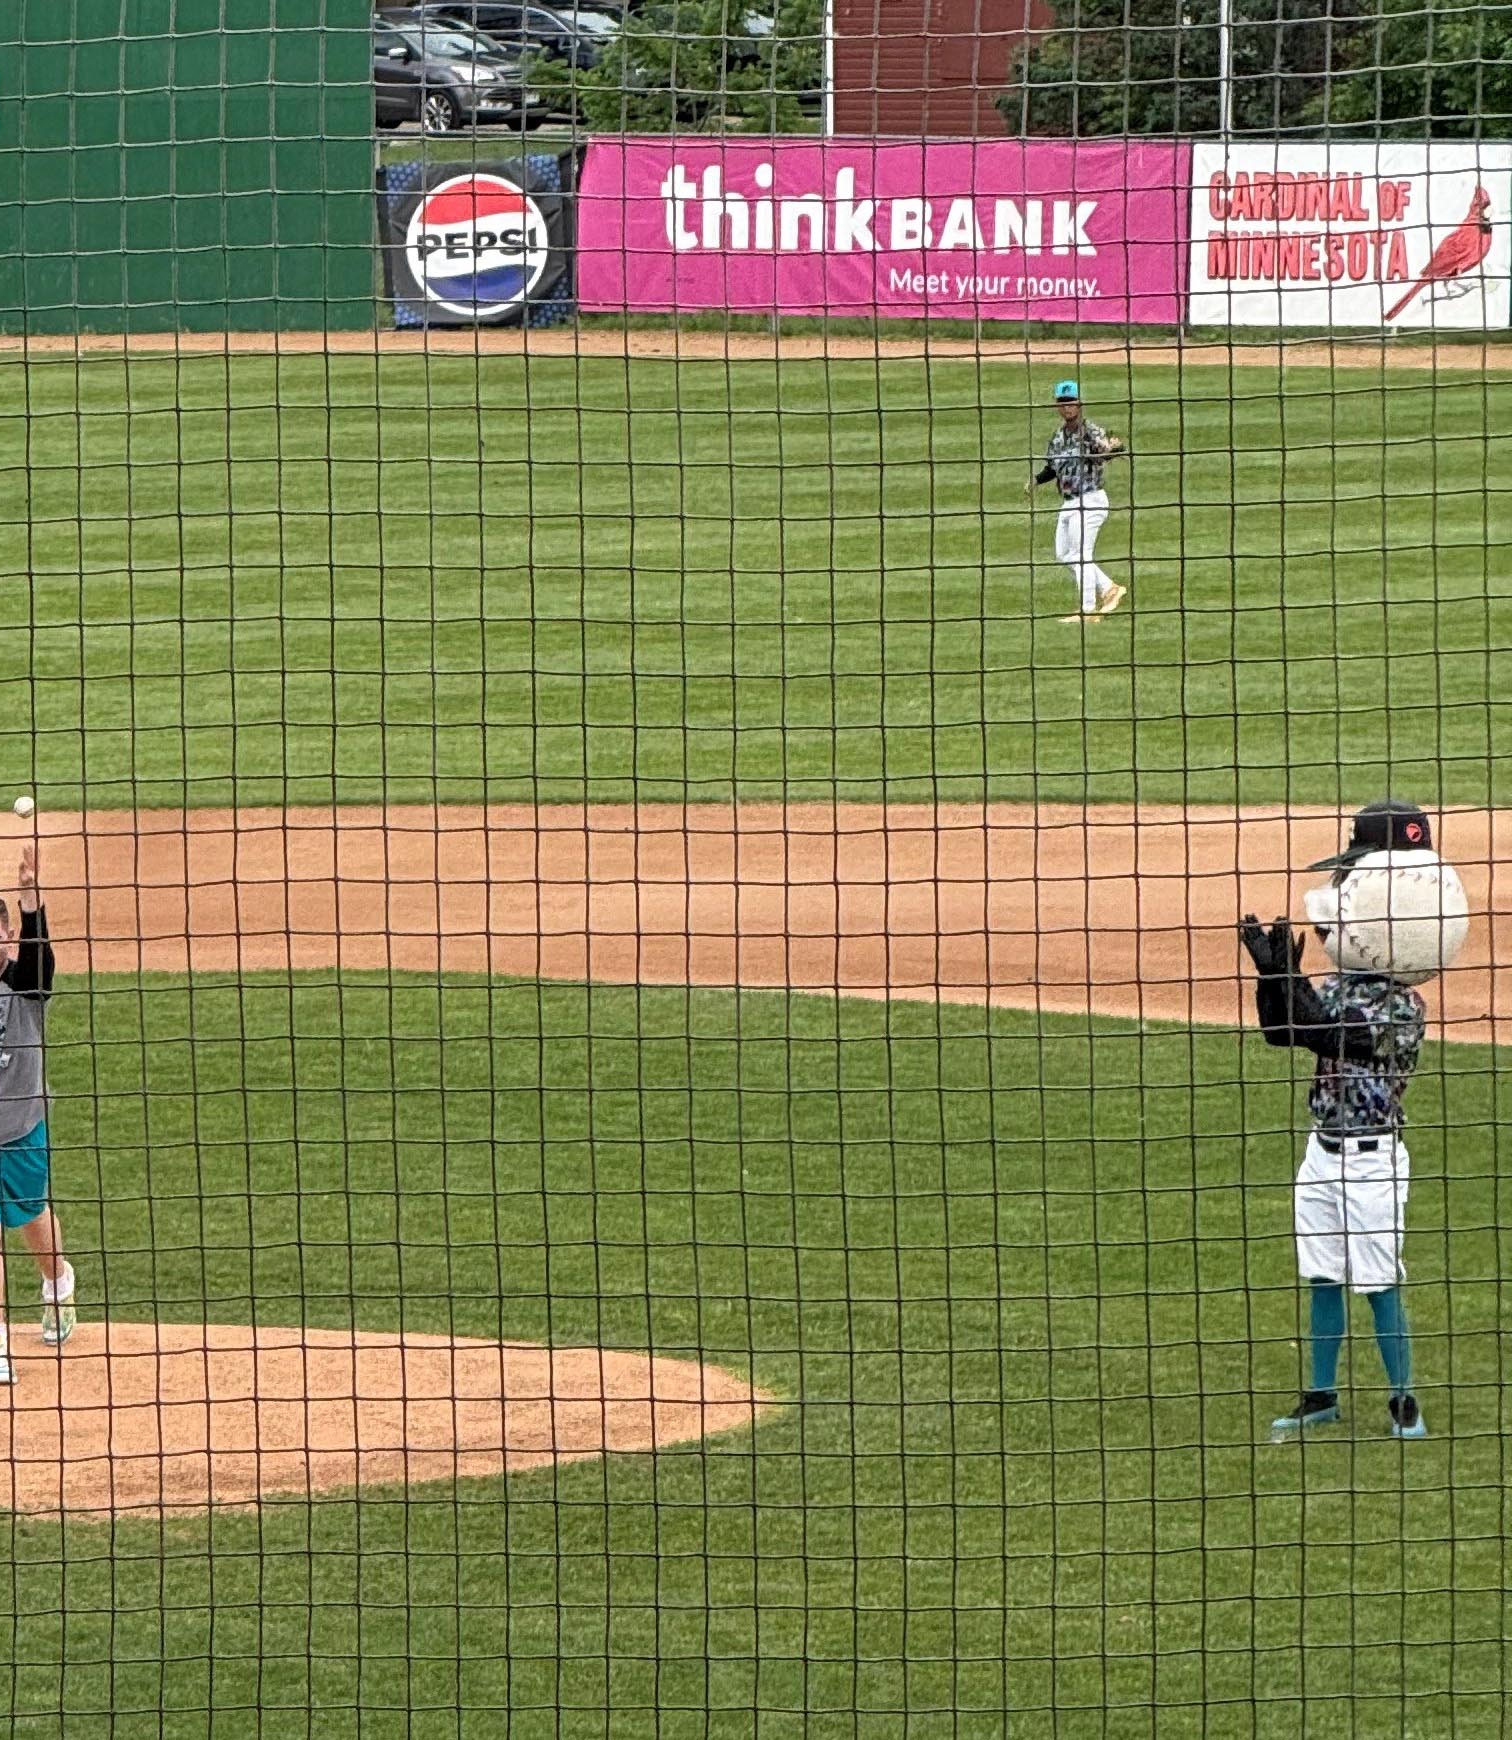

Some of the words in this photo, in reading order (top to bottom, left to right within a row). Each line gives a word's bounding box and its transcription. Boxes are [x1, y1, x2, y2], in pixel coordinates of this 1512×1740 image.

[1208, 170, 1370, 222] CARDINAL
[1379, 181, 1412, 222] OF
[416, 227, 539, 261] PEPSI
[1207, 231, 1410, 281] MINNESOTA
[889, 268, 949, 293] Meet
[956, 275, 1010, 298] your
[1017, 277, 1101, 297] money.
